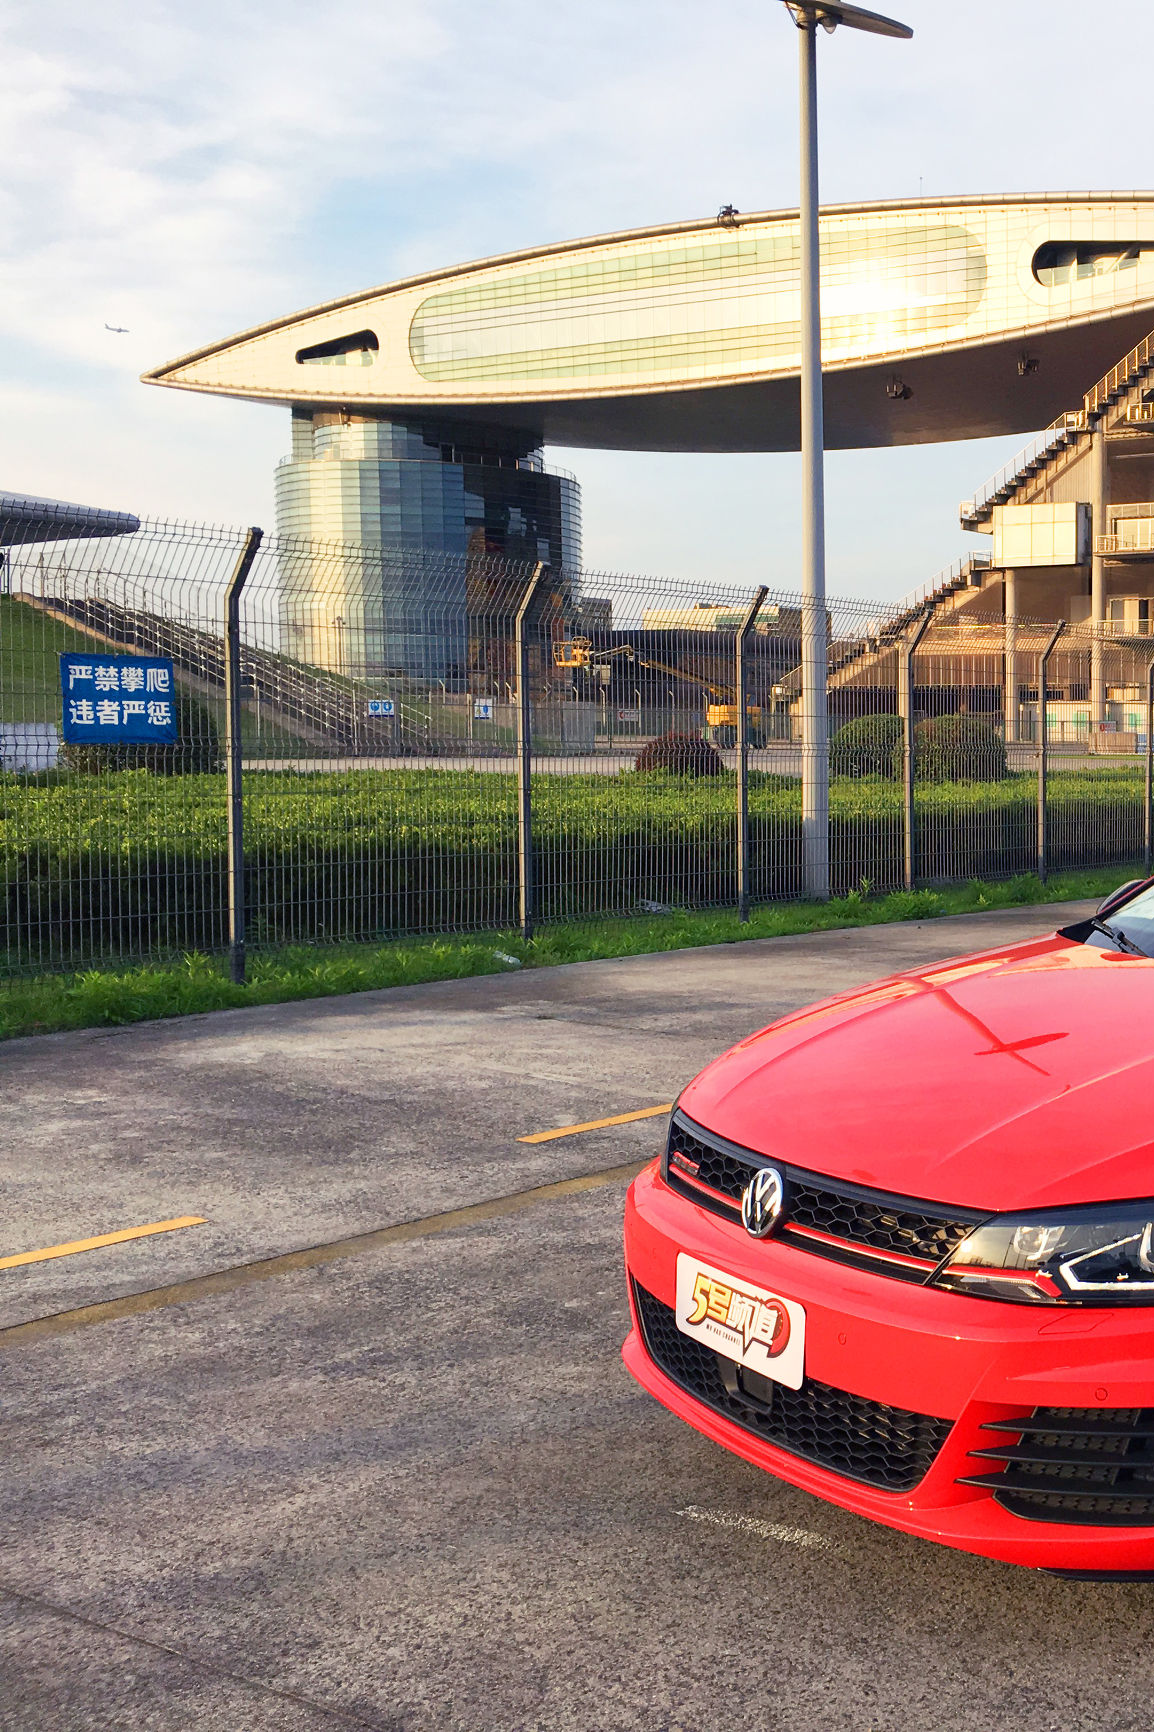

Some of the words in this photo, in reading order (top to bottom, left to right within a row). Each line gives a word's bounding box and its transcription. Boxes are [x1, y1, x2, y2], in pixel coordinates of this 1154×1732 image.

[68, 665, 170, 693] 严禁攀爬
[69, 698, 171, 726] 违者严惩
